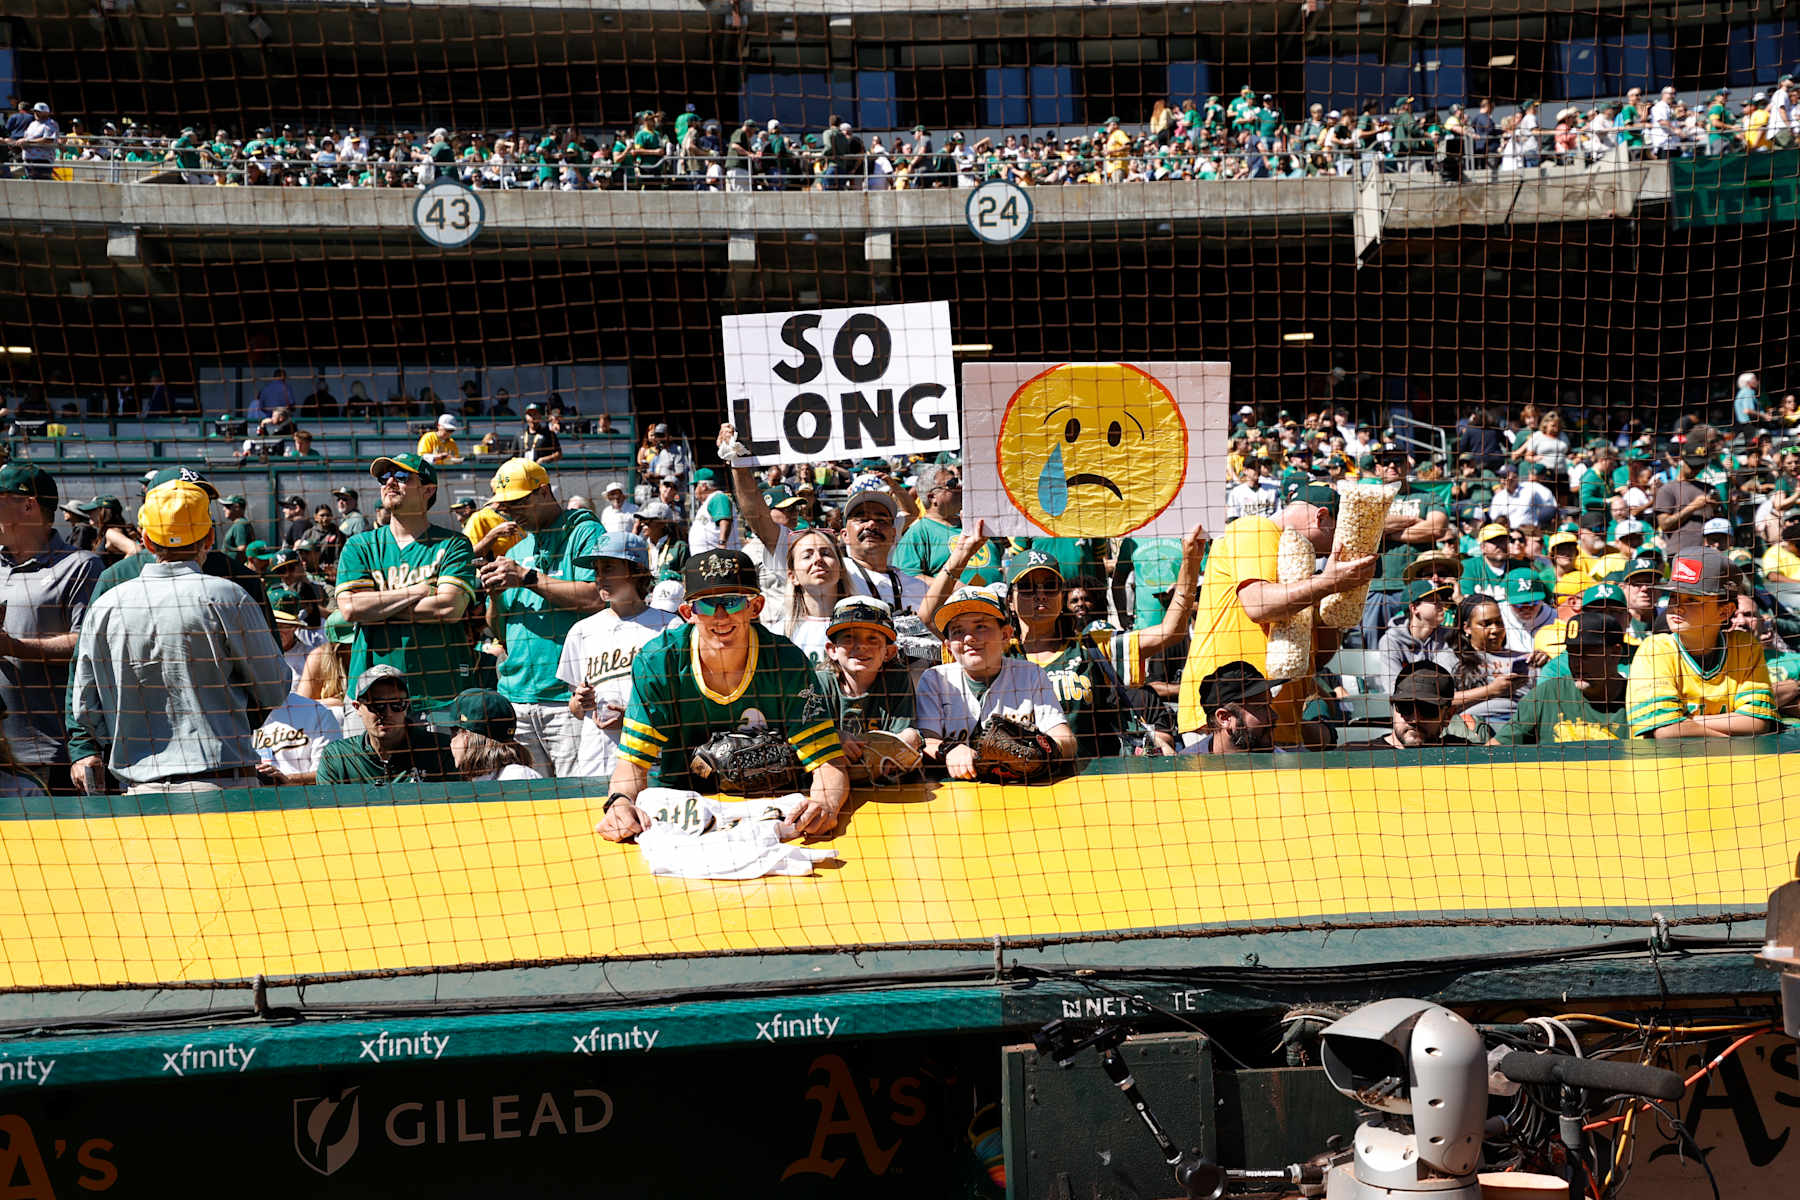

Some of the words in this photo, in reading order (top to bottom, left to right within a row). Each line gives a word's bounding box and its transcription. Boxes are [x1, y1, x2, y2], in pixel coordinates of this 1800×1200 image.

[425, 198, 470, 230] 43
[979, 196, 1018, 227] 24
[772, 313, 892, 385] SO
[732, 382, 949, 458] LONG
[572, 1025, 660, 1056] xfinity
[755, 1012, 840, 1043] xfinity
[162, 1043, 256, 1076] xfinity
[359, 1031, 450, 1063] xfinity
[385, 1088, 614, 1147] GILEAD
